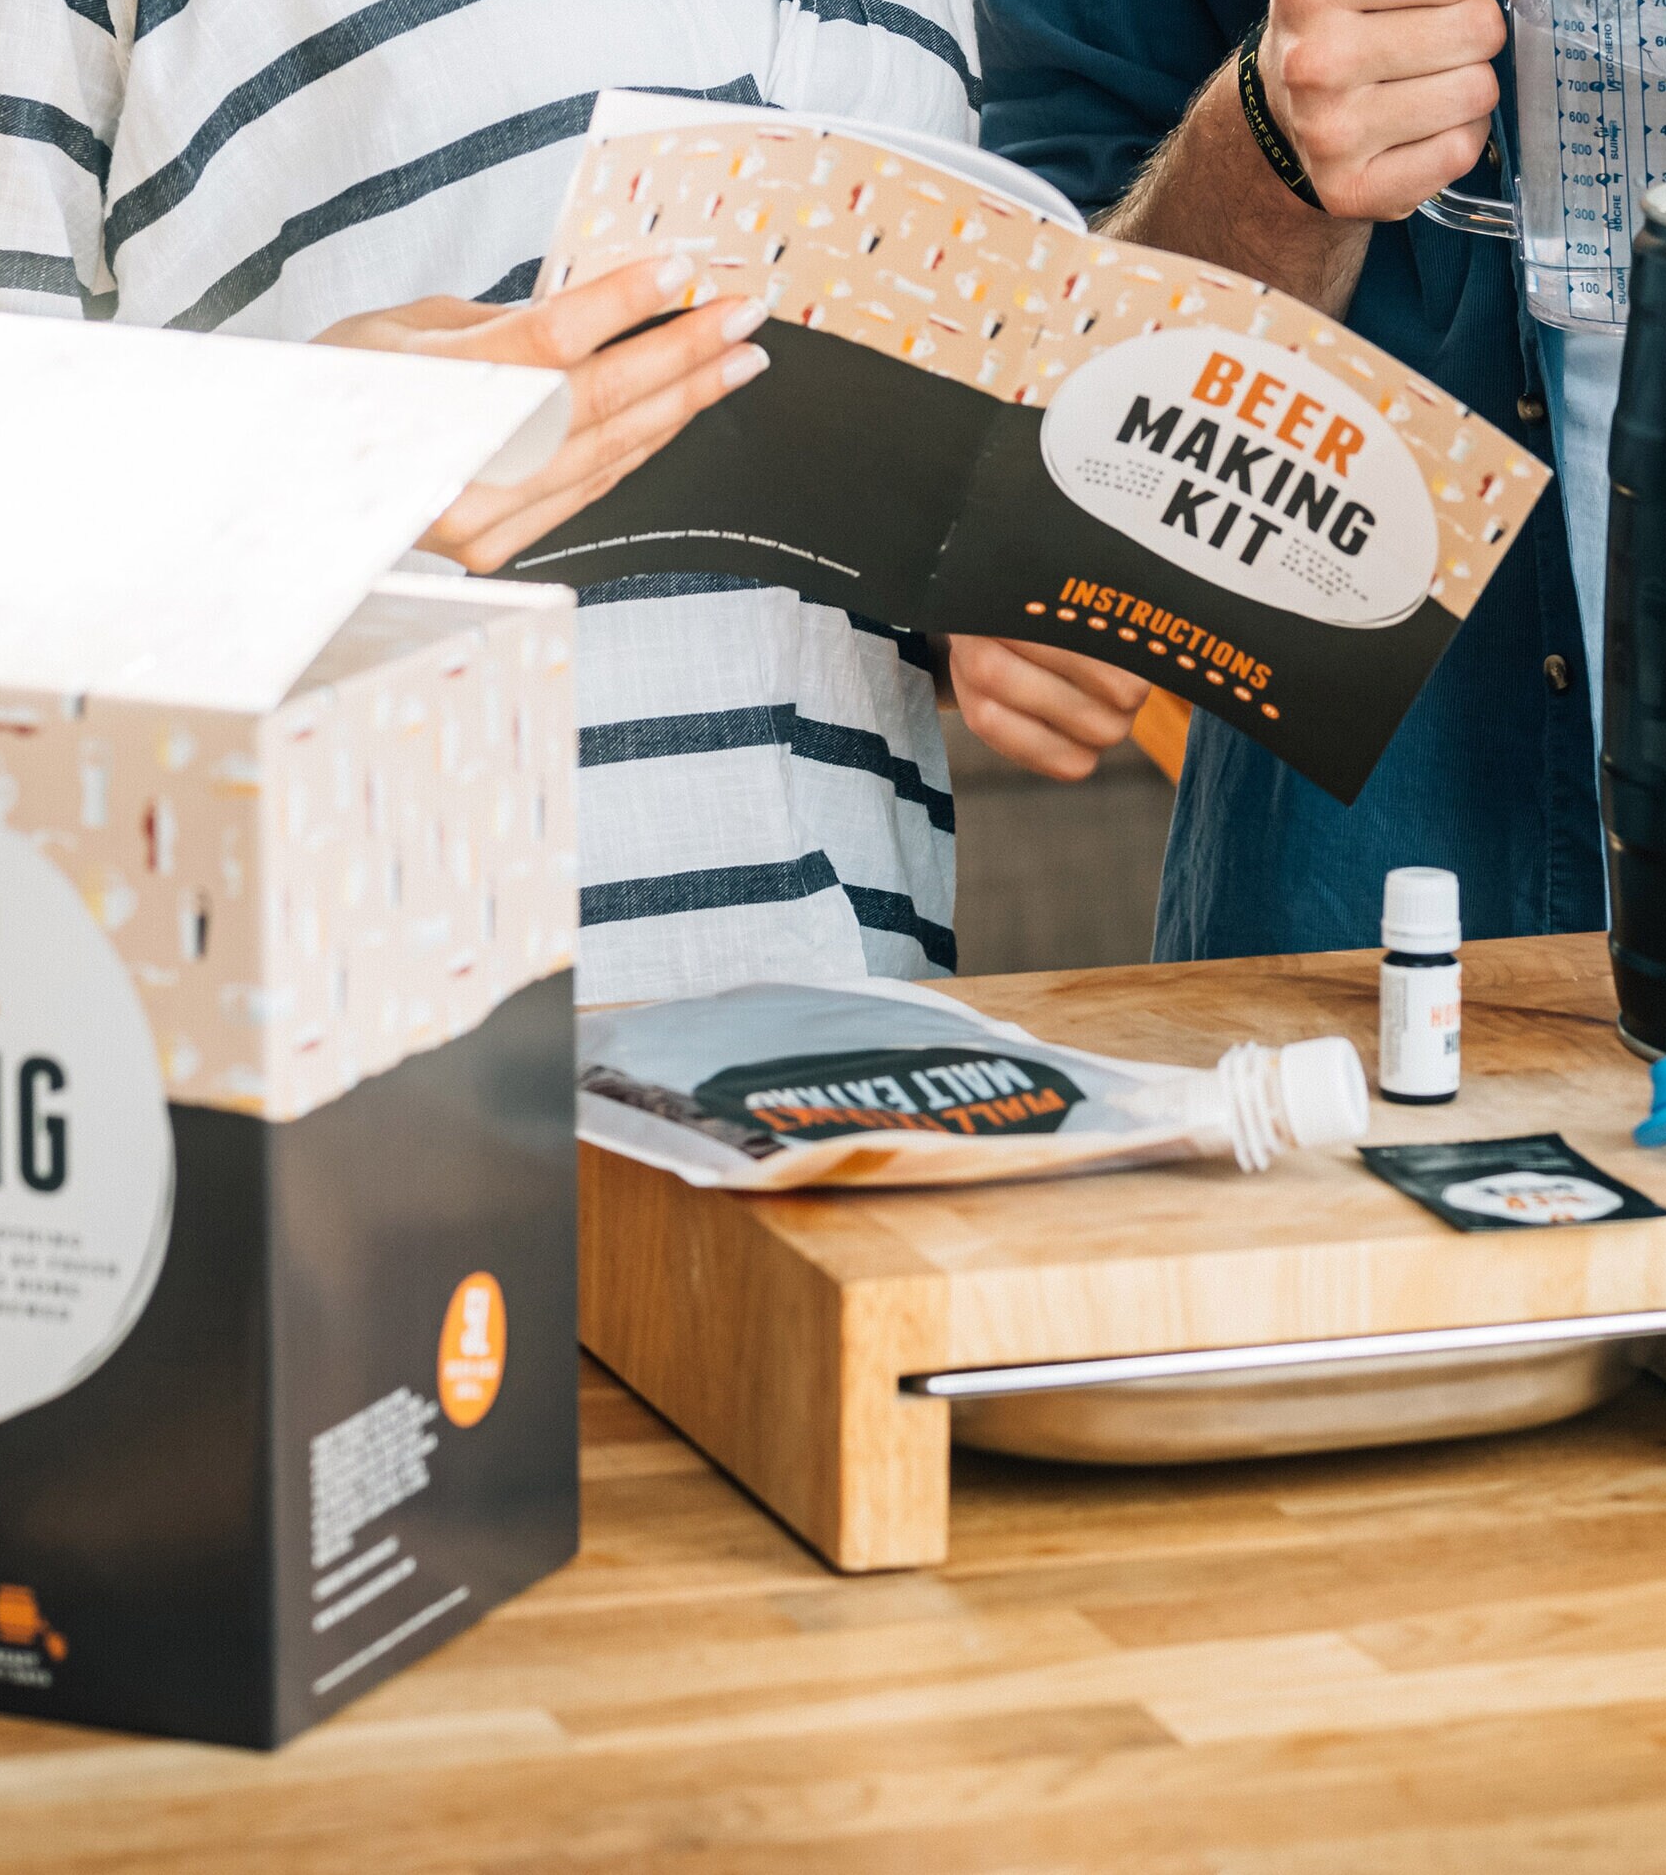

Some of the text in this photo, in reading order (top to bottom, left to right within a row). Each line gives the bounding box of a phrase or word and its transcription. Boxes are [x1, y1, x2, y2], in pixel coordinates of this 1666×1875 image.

[1565, 49, 1587, 61] 800
[1567, 80, 1589, 92] 700
[1243, 70, 1291, 168] TECHFEST
[1569, 112, 1590, 124] 600
[1571, 143, 1592, 156] 500
[1572, 174, 1594, 187] 400
[1574, 208, 1595, 221] 300
[1576, 243, 1597, 256] 200
[1580, 282, 1599, 294] 100
[1618, 267, 1627, 305] SUGAR
[1191, 351, 1365, 478] BEER
[1116, 395, 1376, 556] MAKING
[1161, 479, 1282, 566] KIT
[1060, 577, 1273, 691] INSTRUCTIONS
[910, 1058, 1036, 1110] MALT
